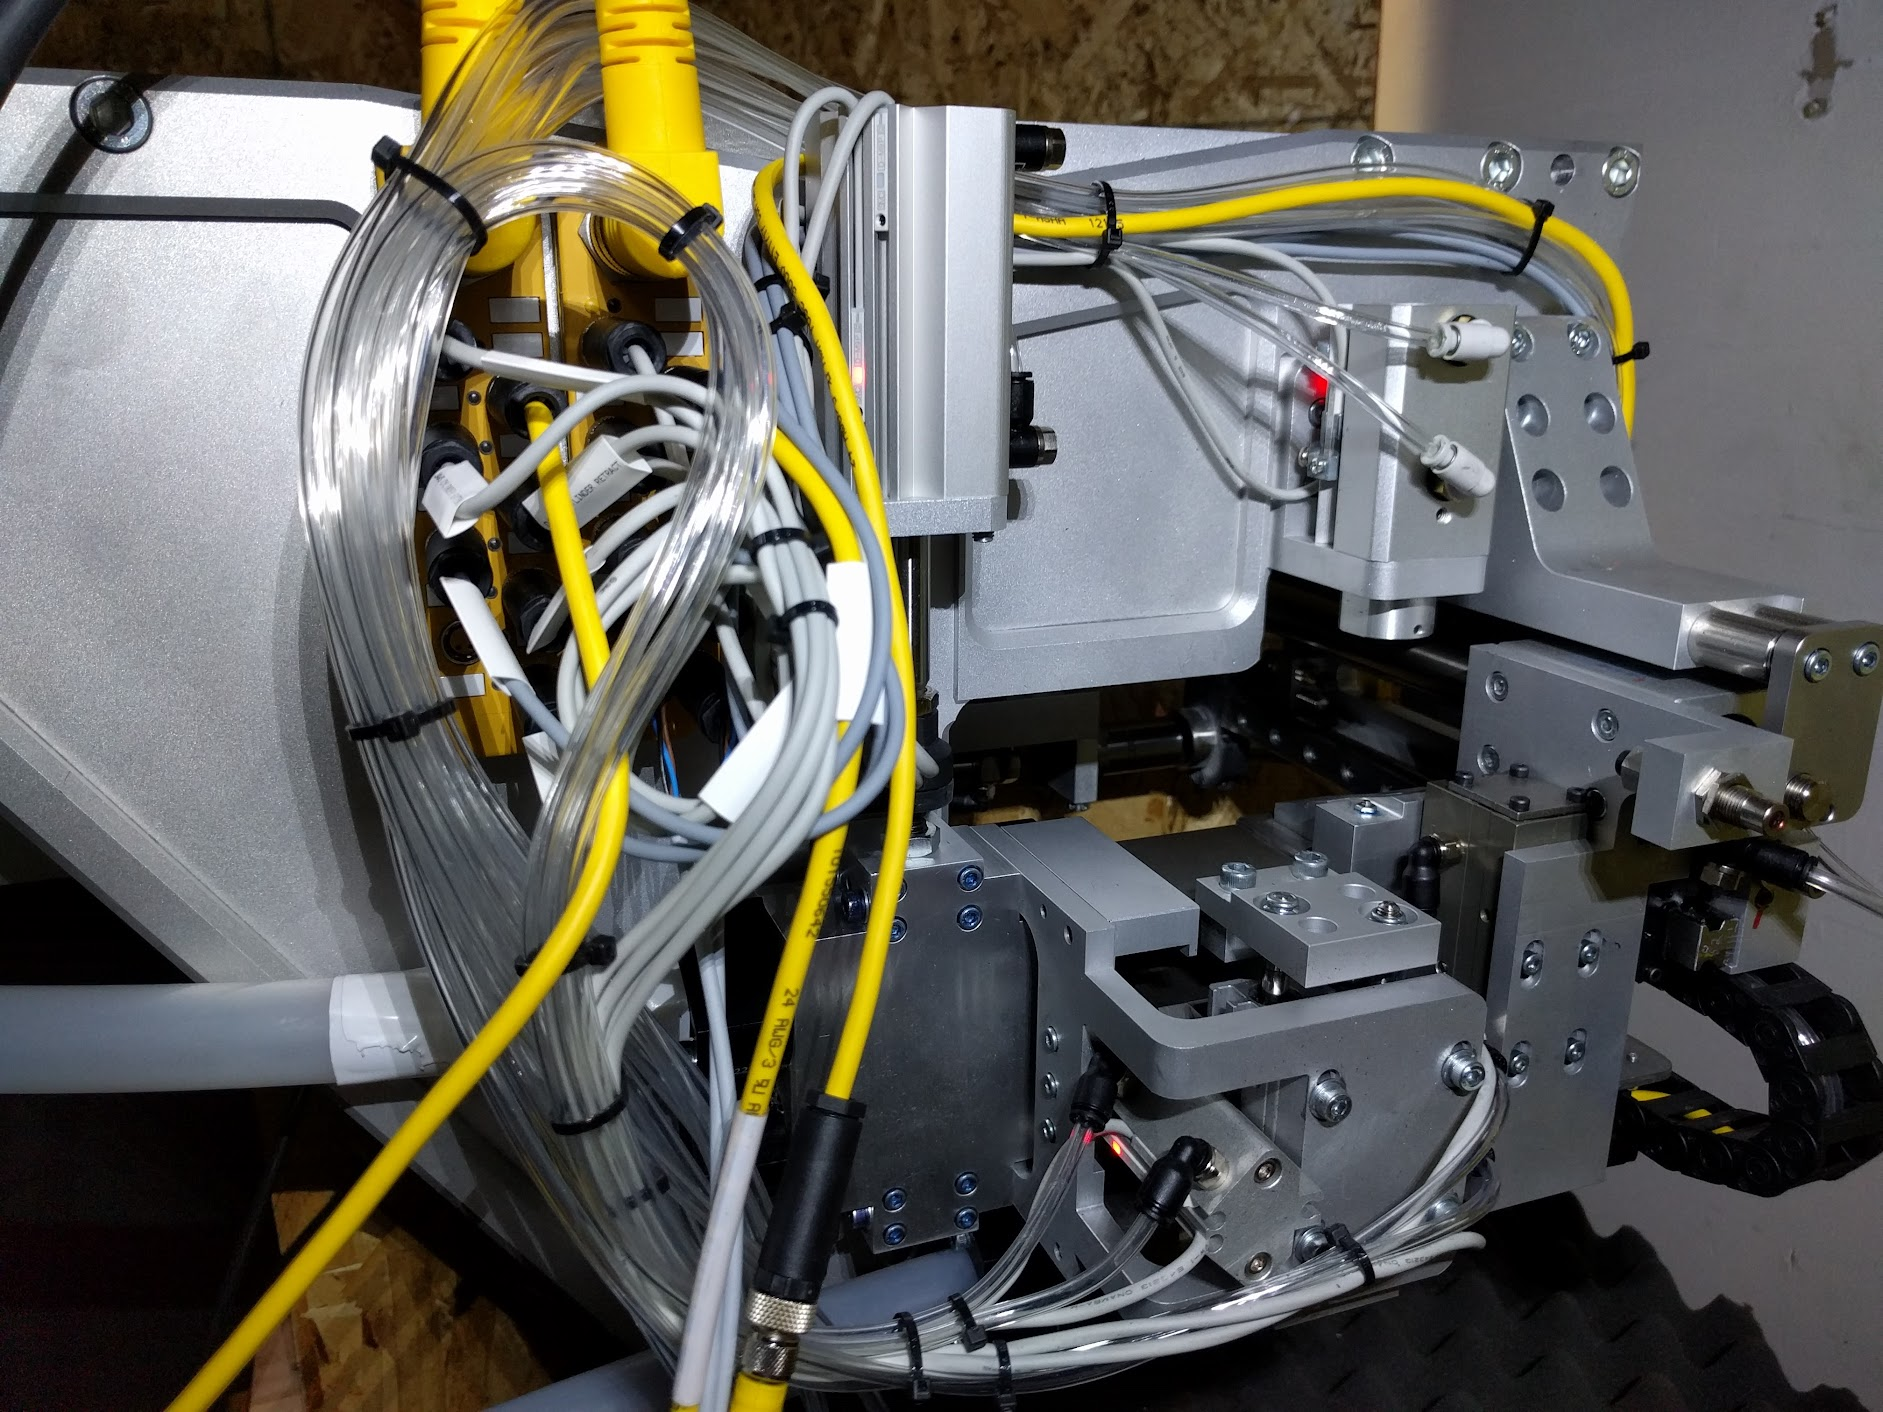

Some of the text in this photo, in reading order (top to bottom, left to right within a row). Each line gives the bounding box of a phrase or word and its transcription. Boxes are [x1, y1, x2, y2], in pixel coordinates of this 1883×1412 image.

[572, 461, 621, 505] LINDER RETRACT
[781, 988, 800, 1007] 24
[761, 1018, 790, 1069] AWG/3
